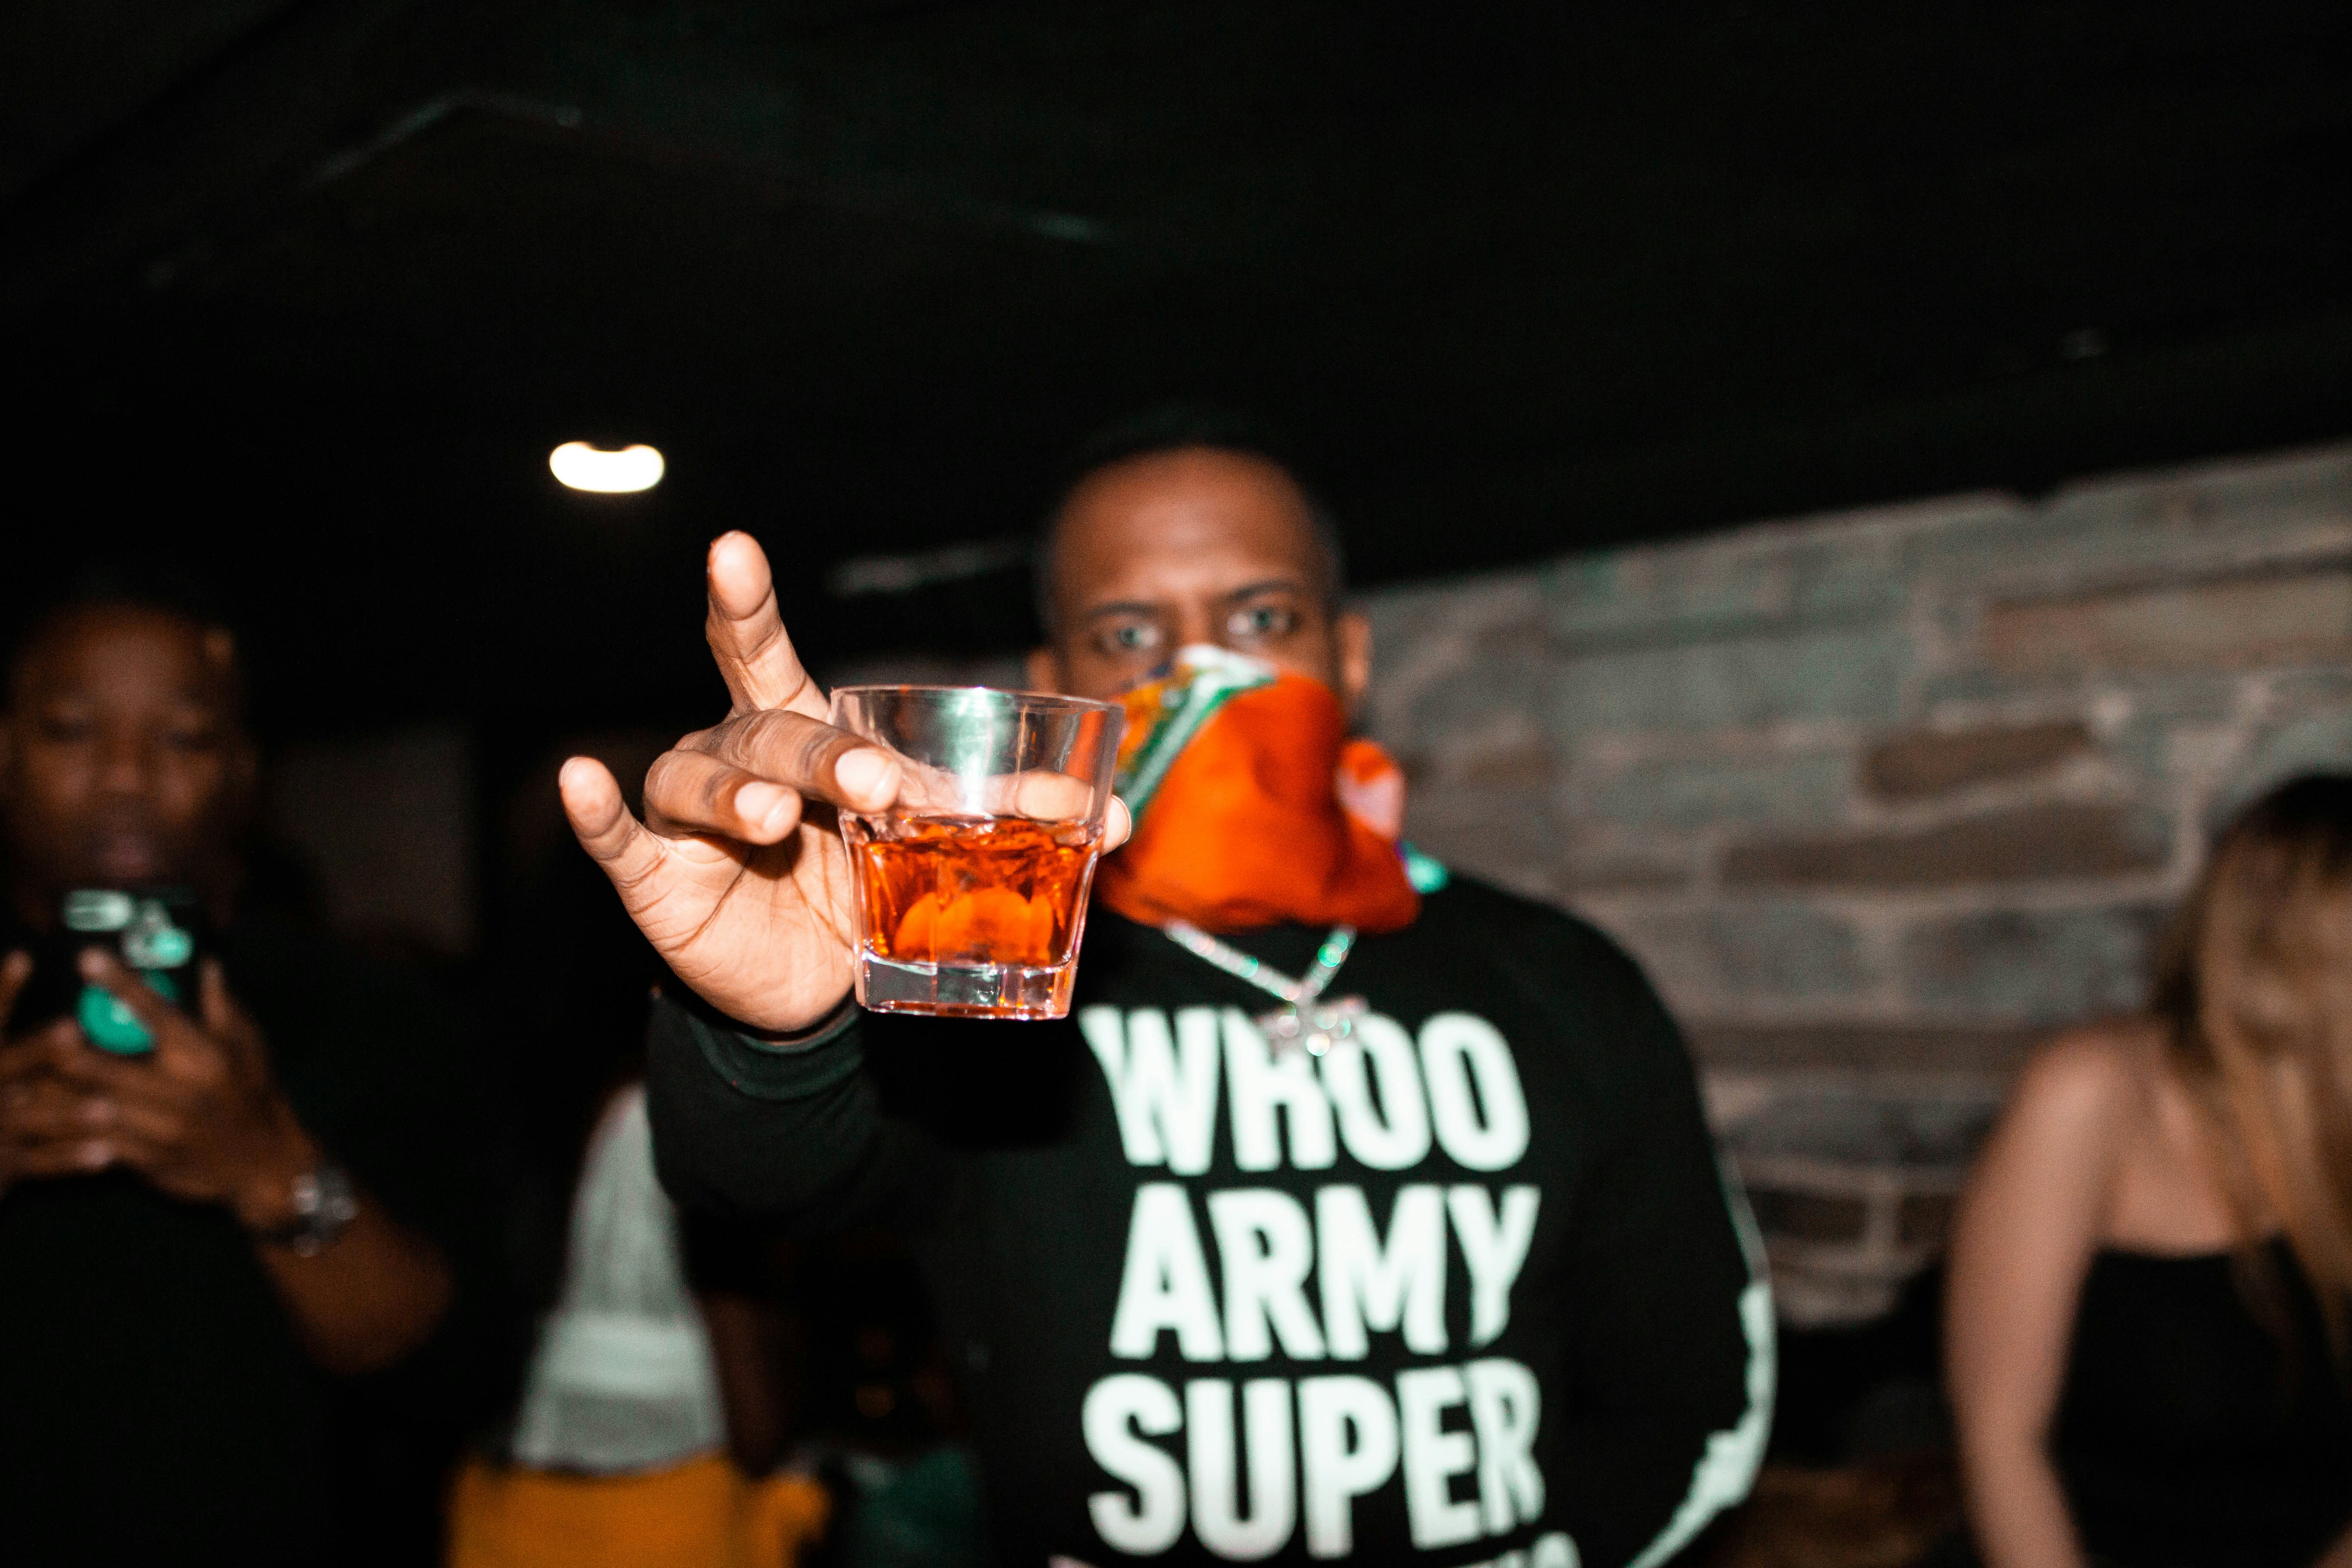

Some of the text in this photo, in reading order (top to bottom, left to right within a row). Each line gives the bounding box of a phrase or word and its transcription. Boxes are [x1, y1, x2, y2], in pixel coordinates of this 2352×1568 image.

[1078, 1006, 1531, 1176] WHOO
[1110, 1182, 1541, 1362] ARMY
[1081, 1358, 1546, 1561] SUPER
